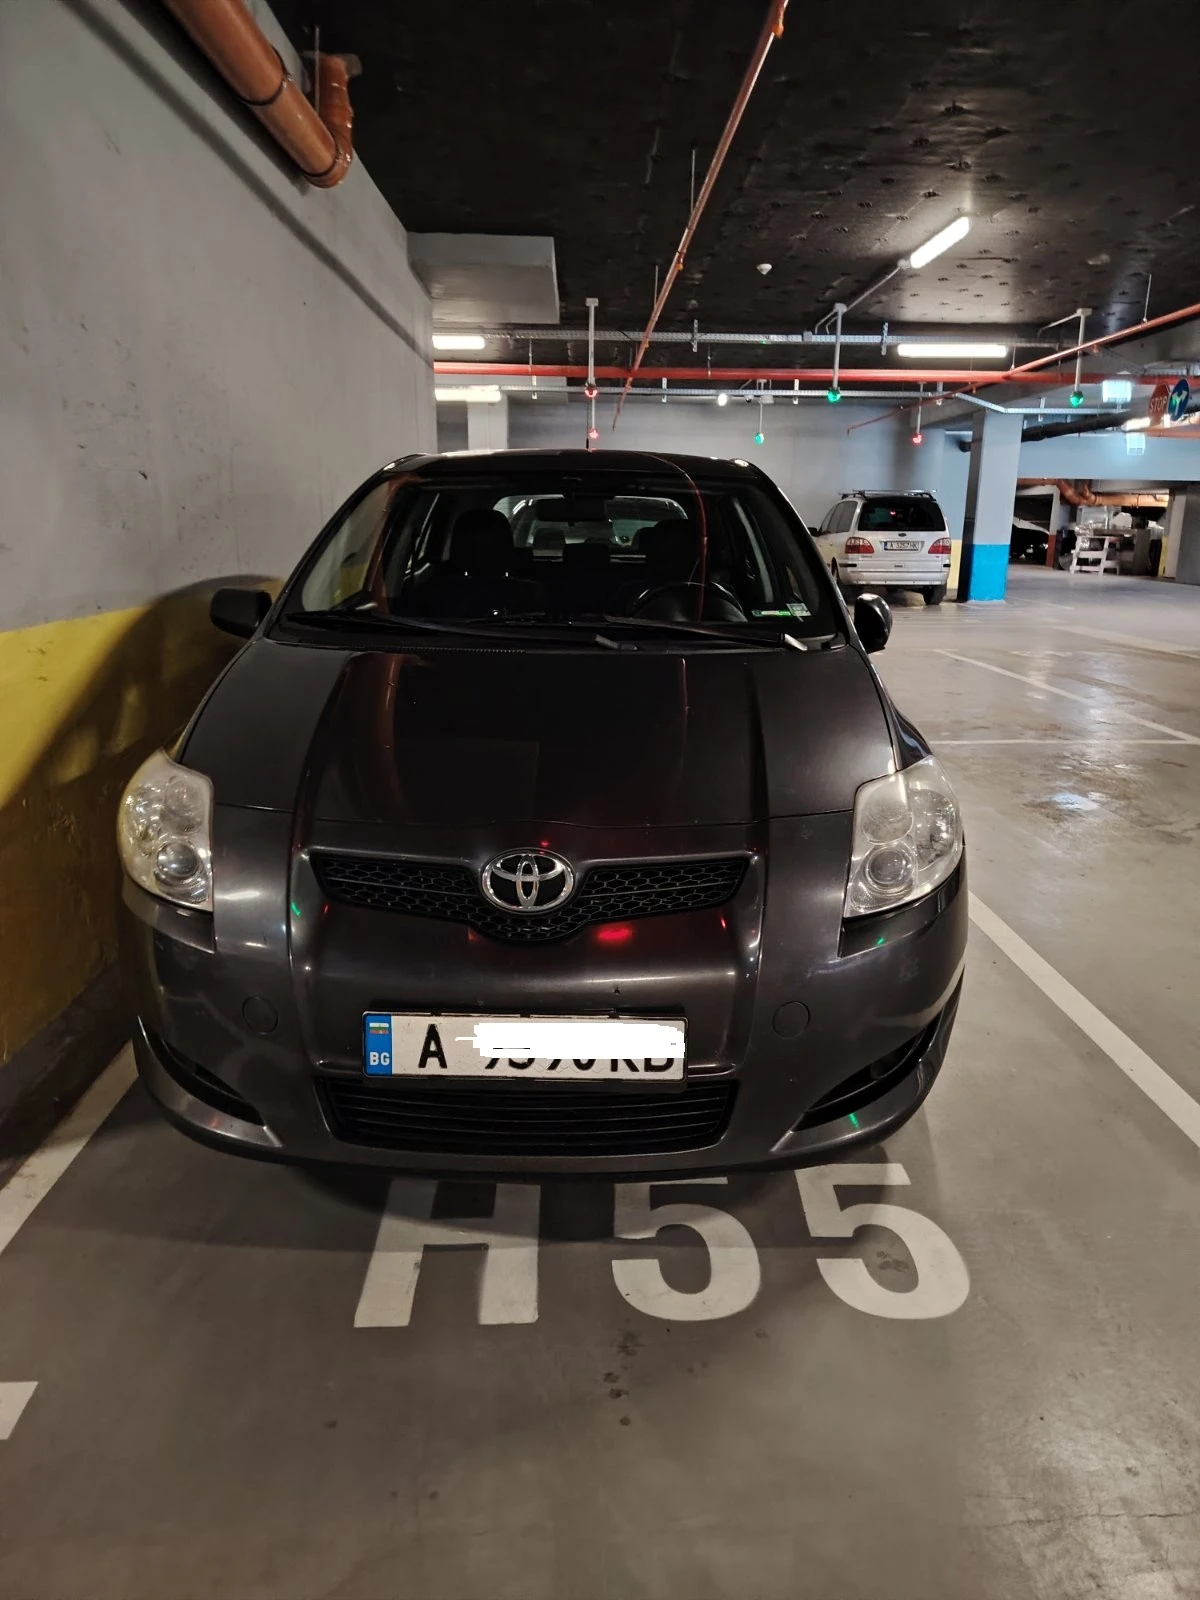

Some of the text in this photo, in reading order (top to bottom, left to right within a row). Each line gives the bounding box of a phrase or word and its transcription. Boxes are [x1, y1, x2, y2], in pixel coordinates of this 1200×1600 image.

[1149, 396, 1168, 413] STOP
[418, 1023, 448, 1069] A
[369, 1051, 390, 1066] BG
